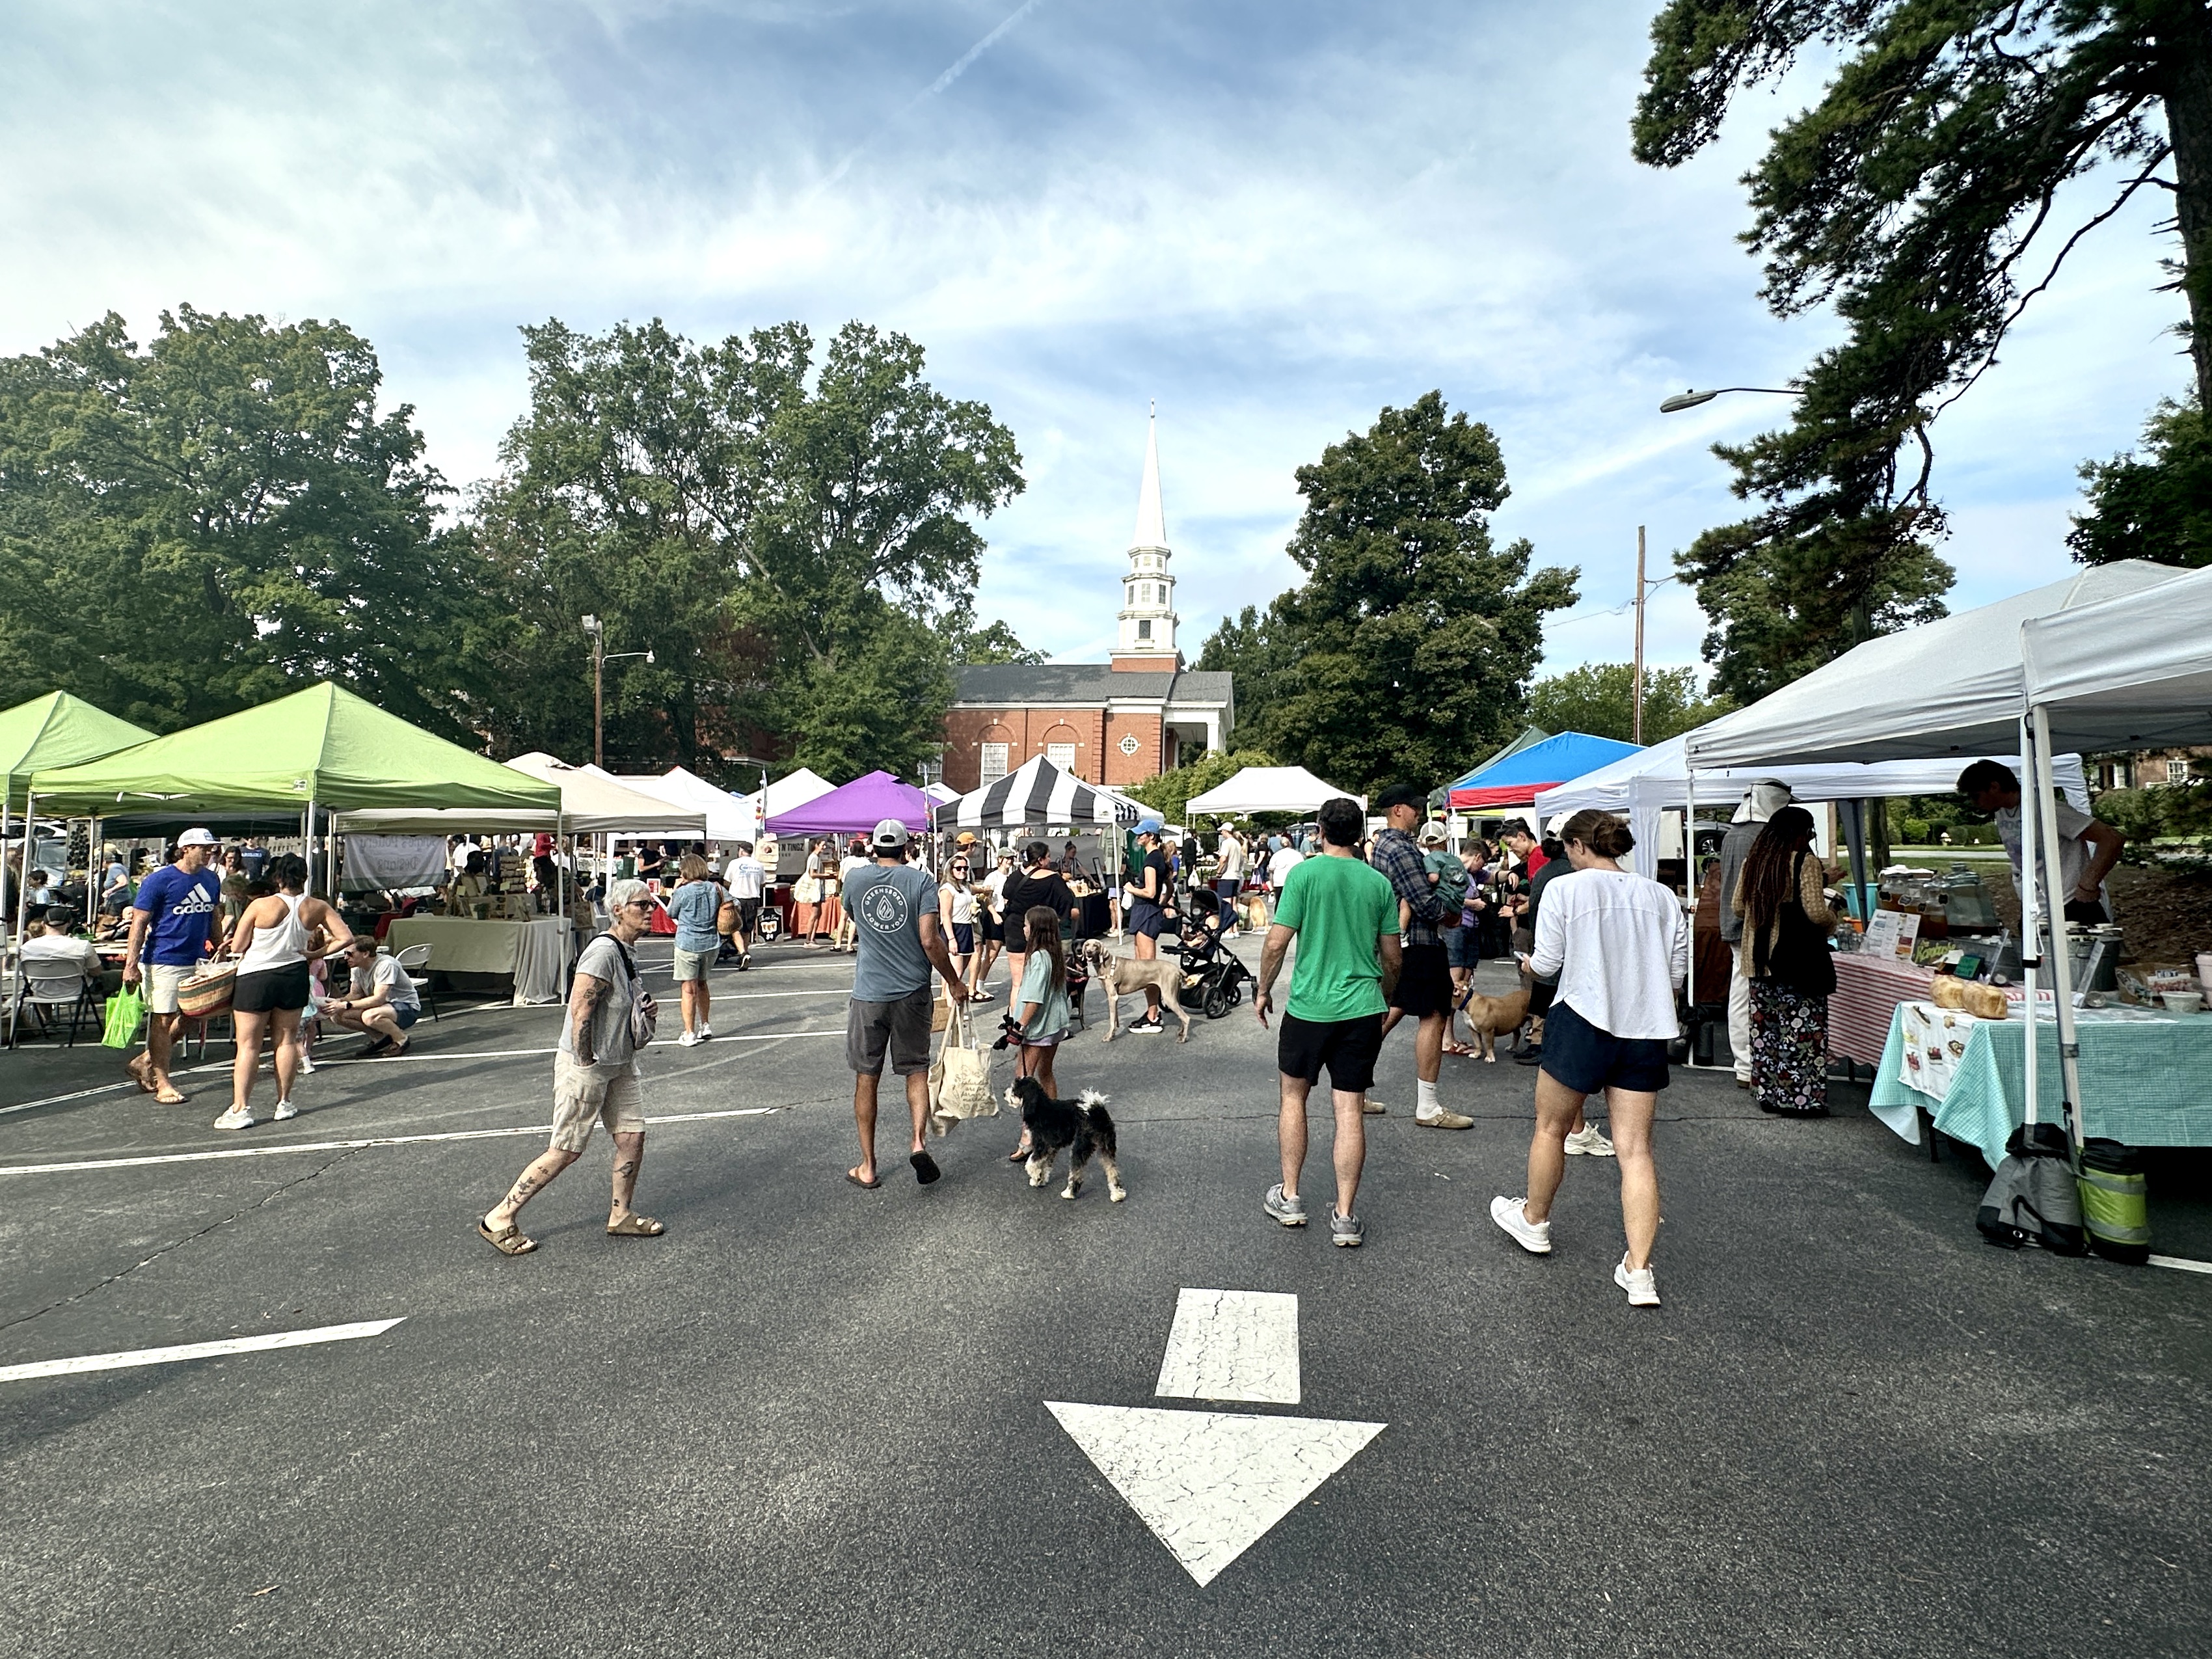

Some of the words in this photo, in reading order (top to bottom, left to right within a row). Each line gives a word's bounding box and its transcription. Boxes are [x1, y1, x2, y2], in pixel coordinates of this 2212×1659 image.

[865, 888, 904, 906] GREENSBORO
[867, 913, 889, 930] POWER
[891, 913, 904, 928] YOGA
